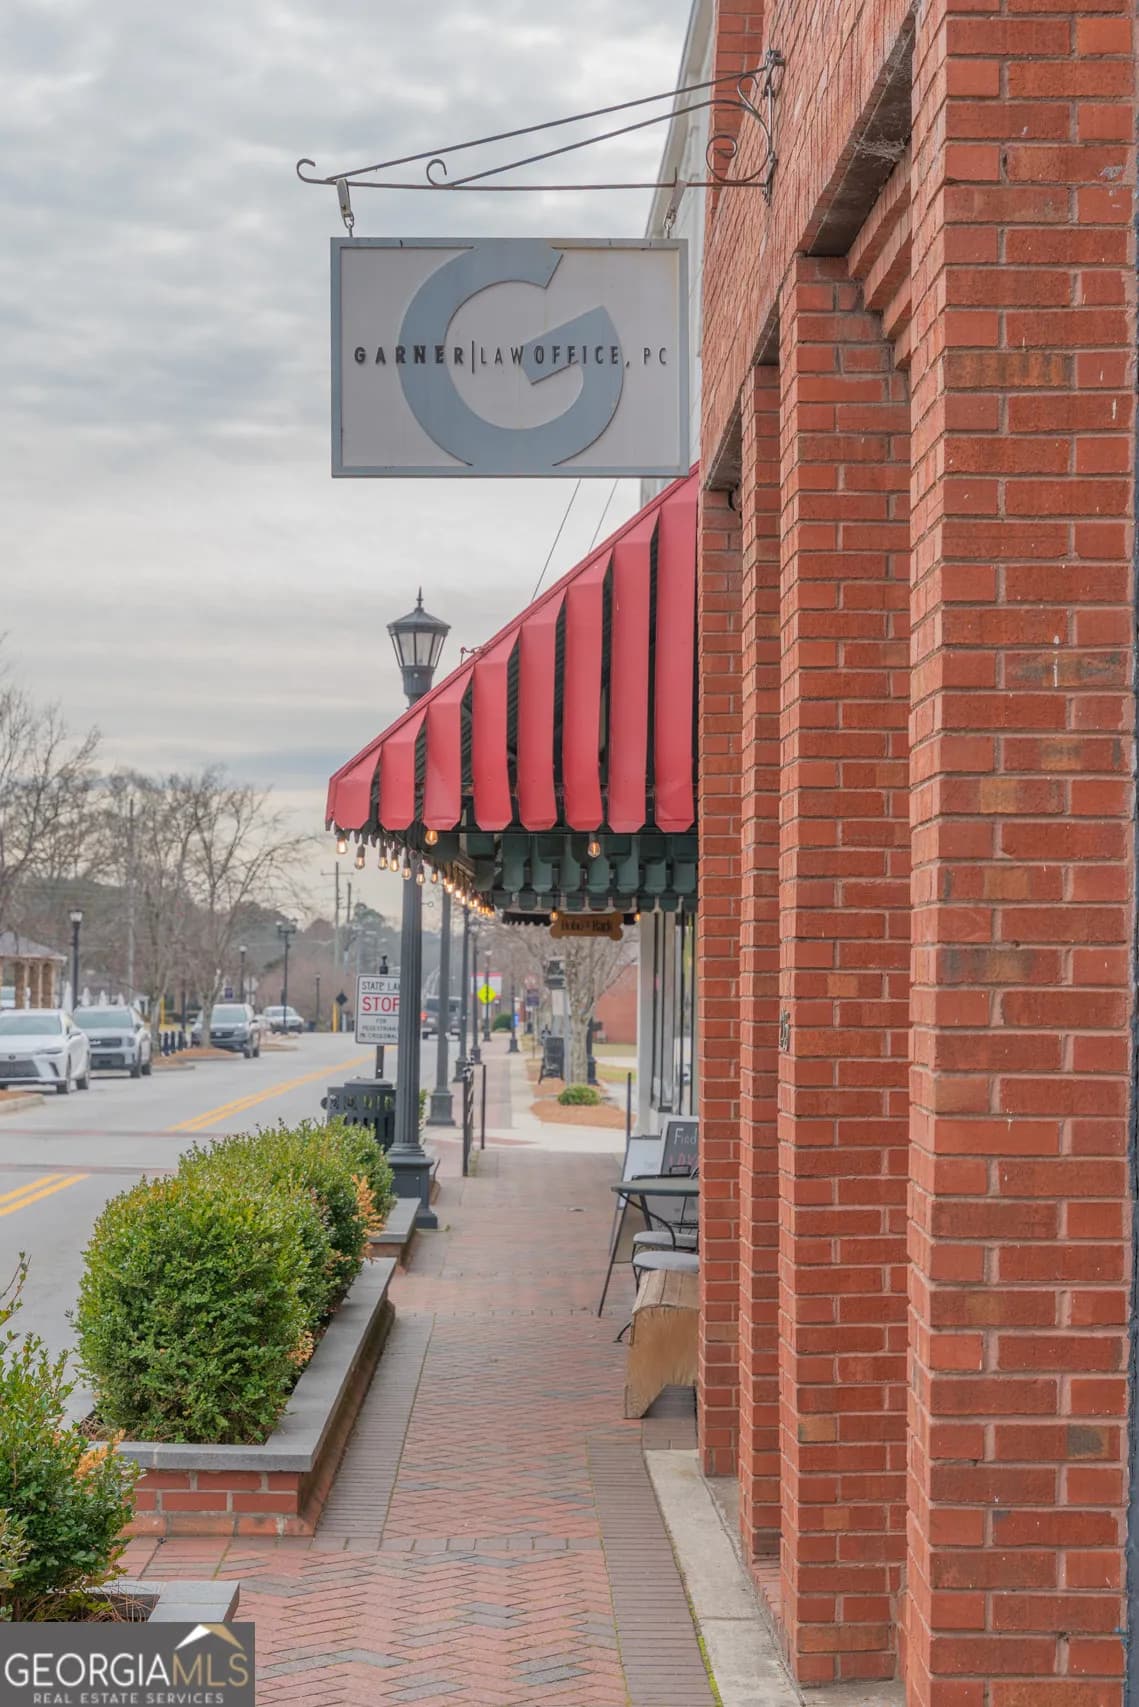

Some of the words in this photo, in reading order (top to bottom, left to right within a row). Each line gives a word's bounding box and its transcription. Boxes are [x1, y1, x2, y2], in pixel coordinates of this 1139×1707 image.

[354, 345, 464, 366] GARNER
[480, 345, 525, 366] LAW
[643, 346, 668, 366] PC
[361, 981, 385, 991] STATE
[387, 982, 400, 992] LA
